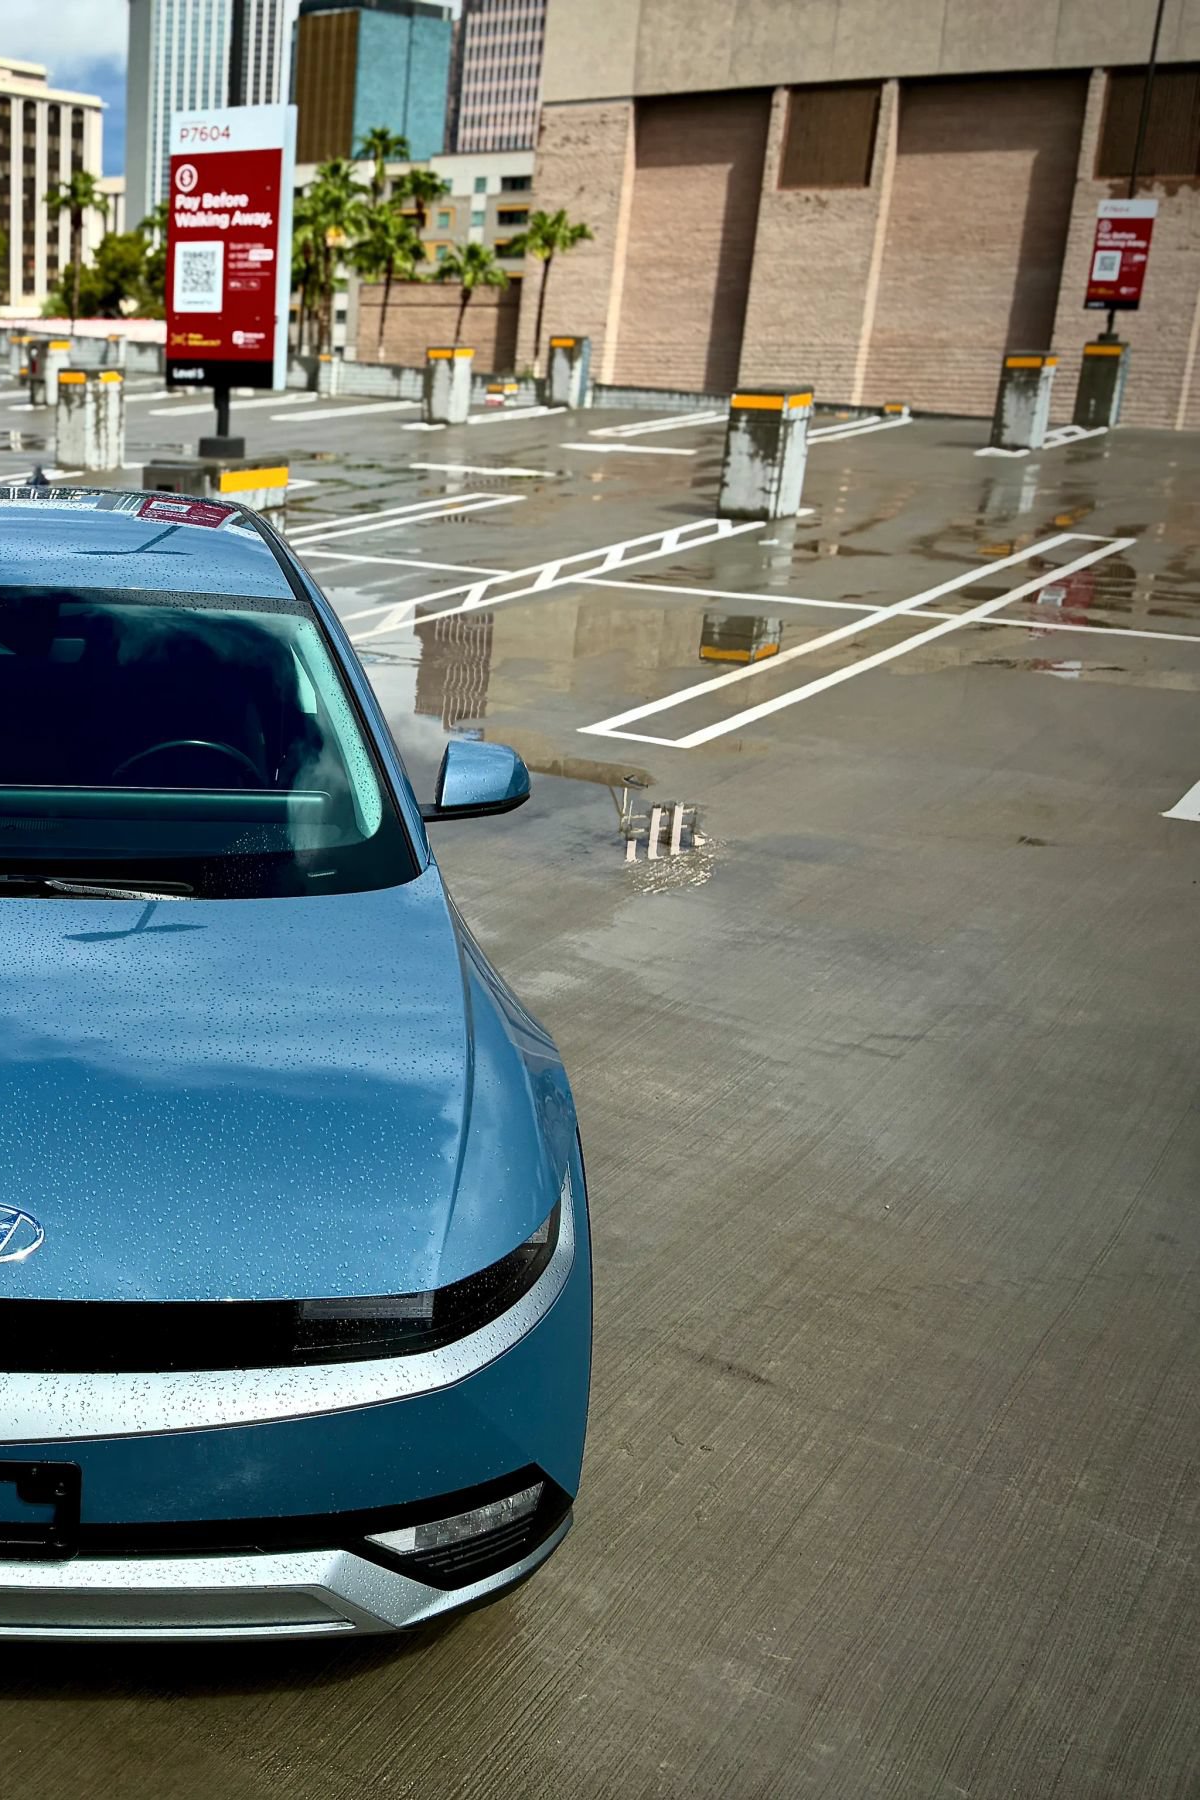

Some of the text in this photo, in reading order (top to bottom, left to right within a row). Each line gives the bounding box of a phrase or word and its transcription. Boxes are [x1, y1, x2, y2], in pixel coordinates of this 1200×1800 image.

[180, 125, 231, 143] P7604
[175, 192, 249, 211] Pay Before
[174, 210, 273, 229] Walking Away.
[173, 368, 196, 379] Level
